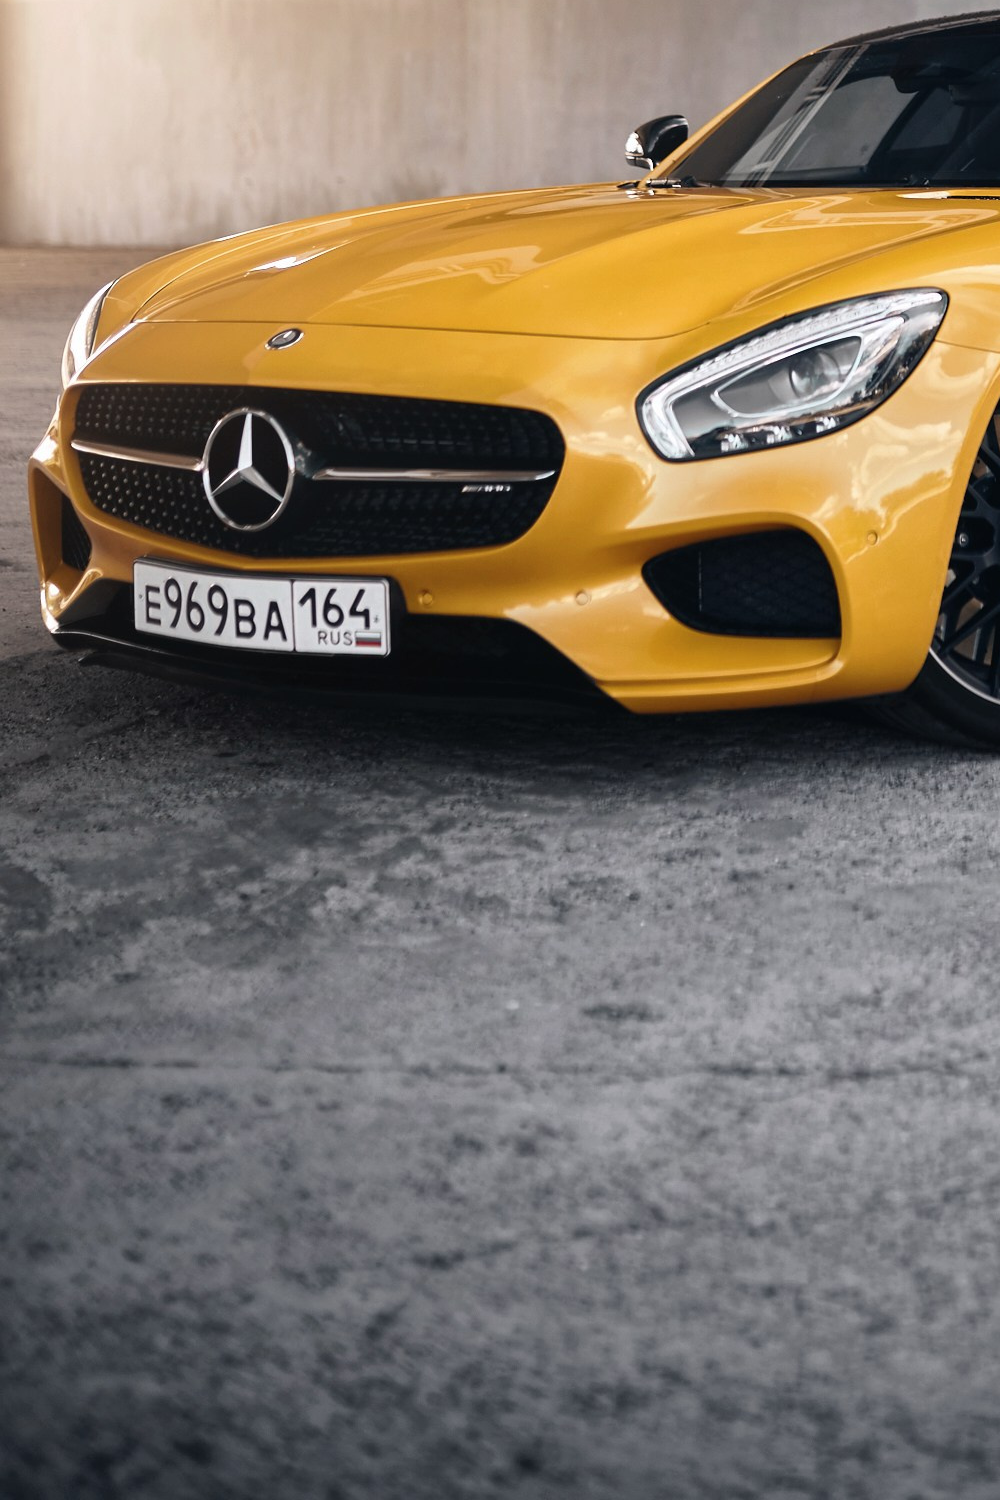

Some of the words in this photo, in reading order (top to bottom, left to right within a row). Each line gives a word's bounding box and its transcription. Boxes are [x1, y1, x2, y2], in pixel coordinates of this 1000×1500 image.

[145, 577, 288, 642] E969BA
[298, 587, 370, 630] 164
[317, 630, 353, 646] RUS
